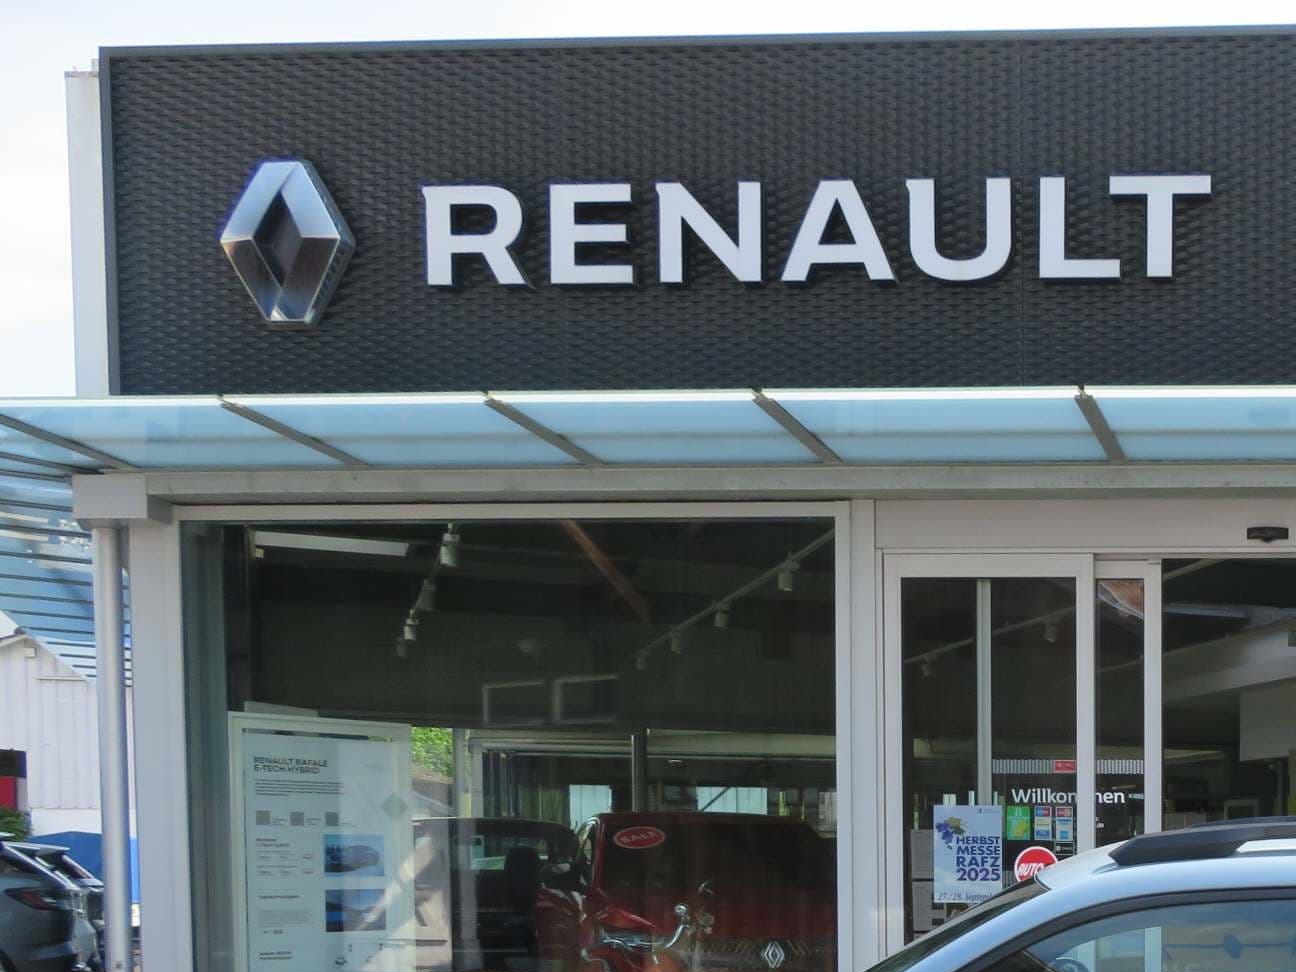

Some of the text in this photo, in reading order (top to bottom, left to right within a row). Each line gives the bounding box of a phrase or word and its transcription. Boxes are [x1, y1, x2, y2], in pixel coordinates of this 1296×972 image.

[422, 174, 1212, 286] RENAULT
[253, 756, 329, 768] RENAULT RAFALE
[253, 765, 287, 773] E-TECH
[956, 836, 1001, 845] HERBST
[956, 845, 1001, 855] MESSE
[956, 856, 1001, 867] RAFZ
[956, 868, 1001, 882] 2025
